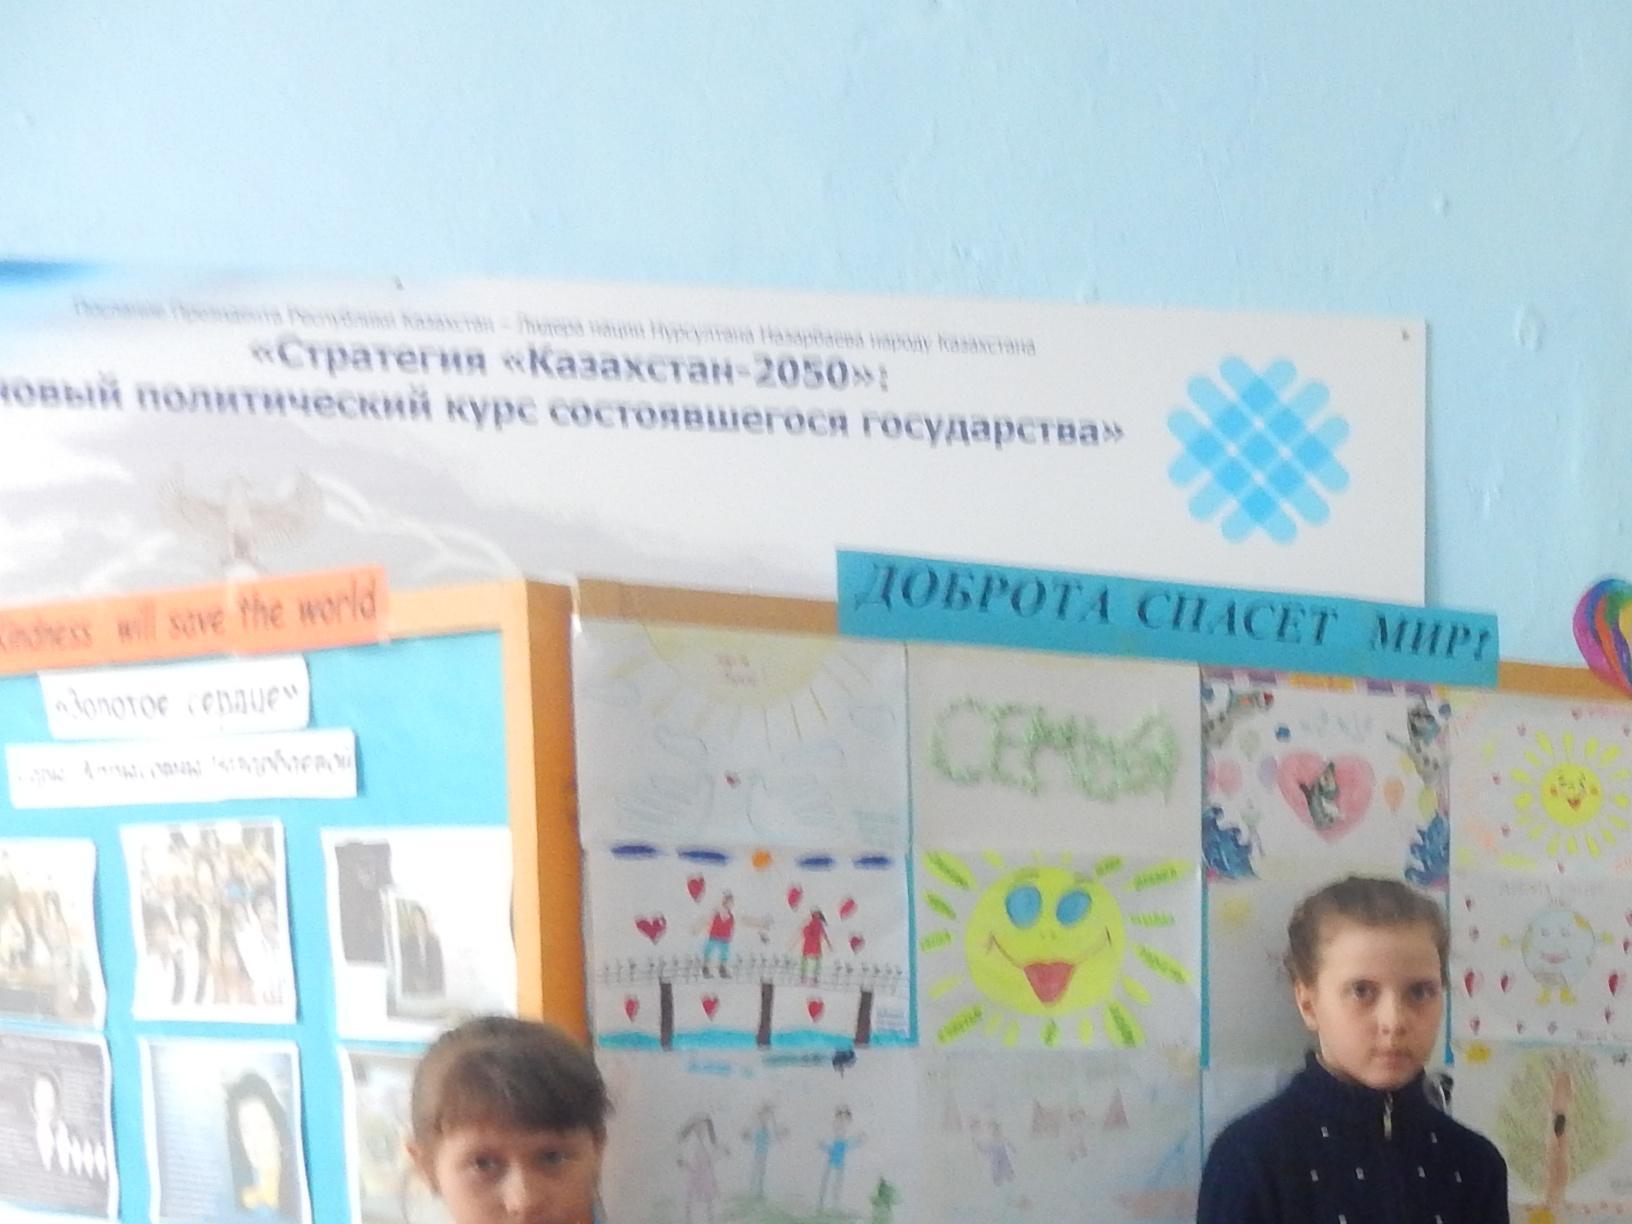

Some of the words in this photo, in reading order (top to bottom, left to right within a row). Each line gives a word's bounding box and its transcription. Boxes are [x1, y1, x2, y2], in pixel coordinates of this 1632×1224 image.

[248, 332, 487, 379] «Стратегия
[500, 341, 888, 394] «Казахстан-2050»:
[135, 382, 433, 422] политический
[443, 393, 540, 432] курс
[548, 396, 850, 440] состоявшегося
[860, 407, 1126, 451] государства»
[116, 596, 157, 644] will
[167, 604, 226, 641] save
[237, 585, 285, 632] the
[296, 573, 378, 625] world
[852, 561, 1112, 626] ДОБРОТА
[1135, 588, 1340, 648] СПАСЕТ
[1367, 606, 1492, 662] МИР!
